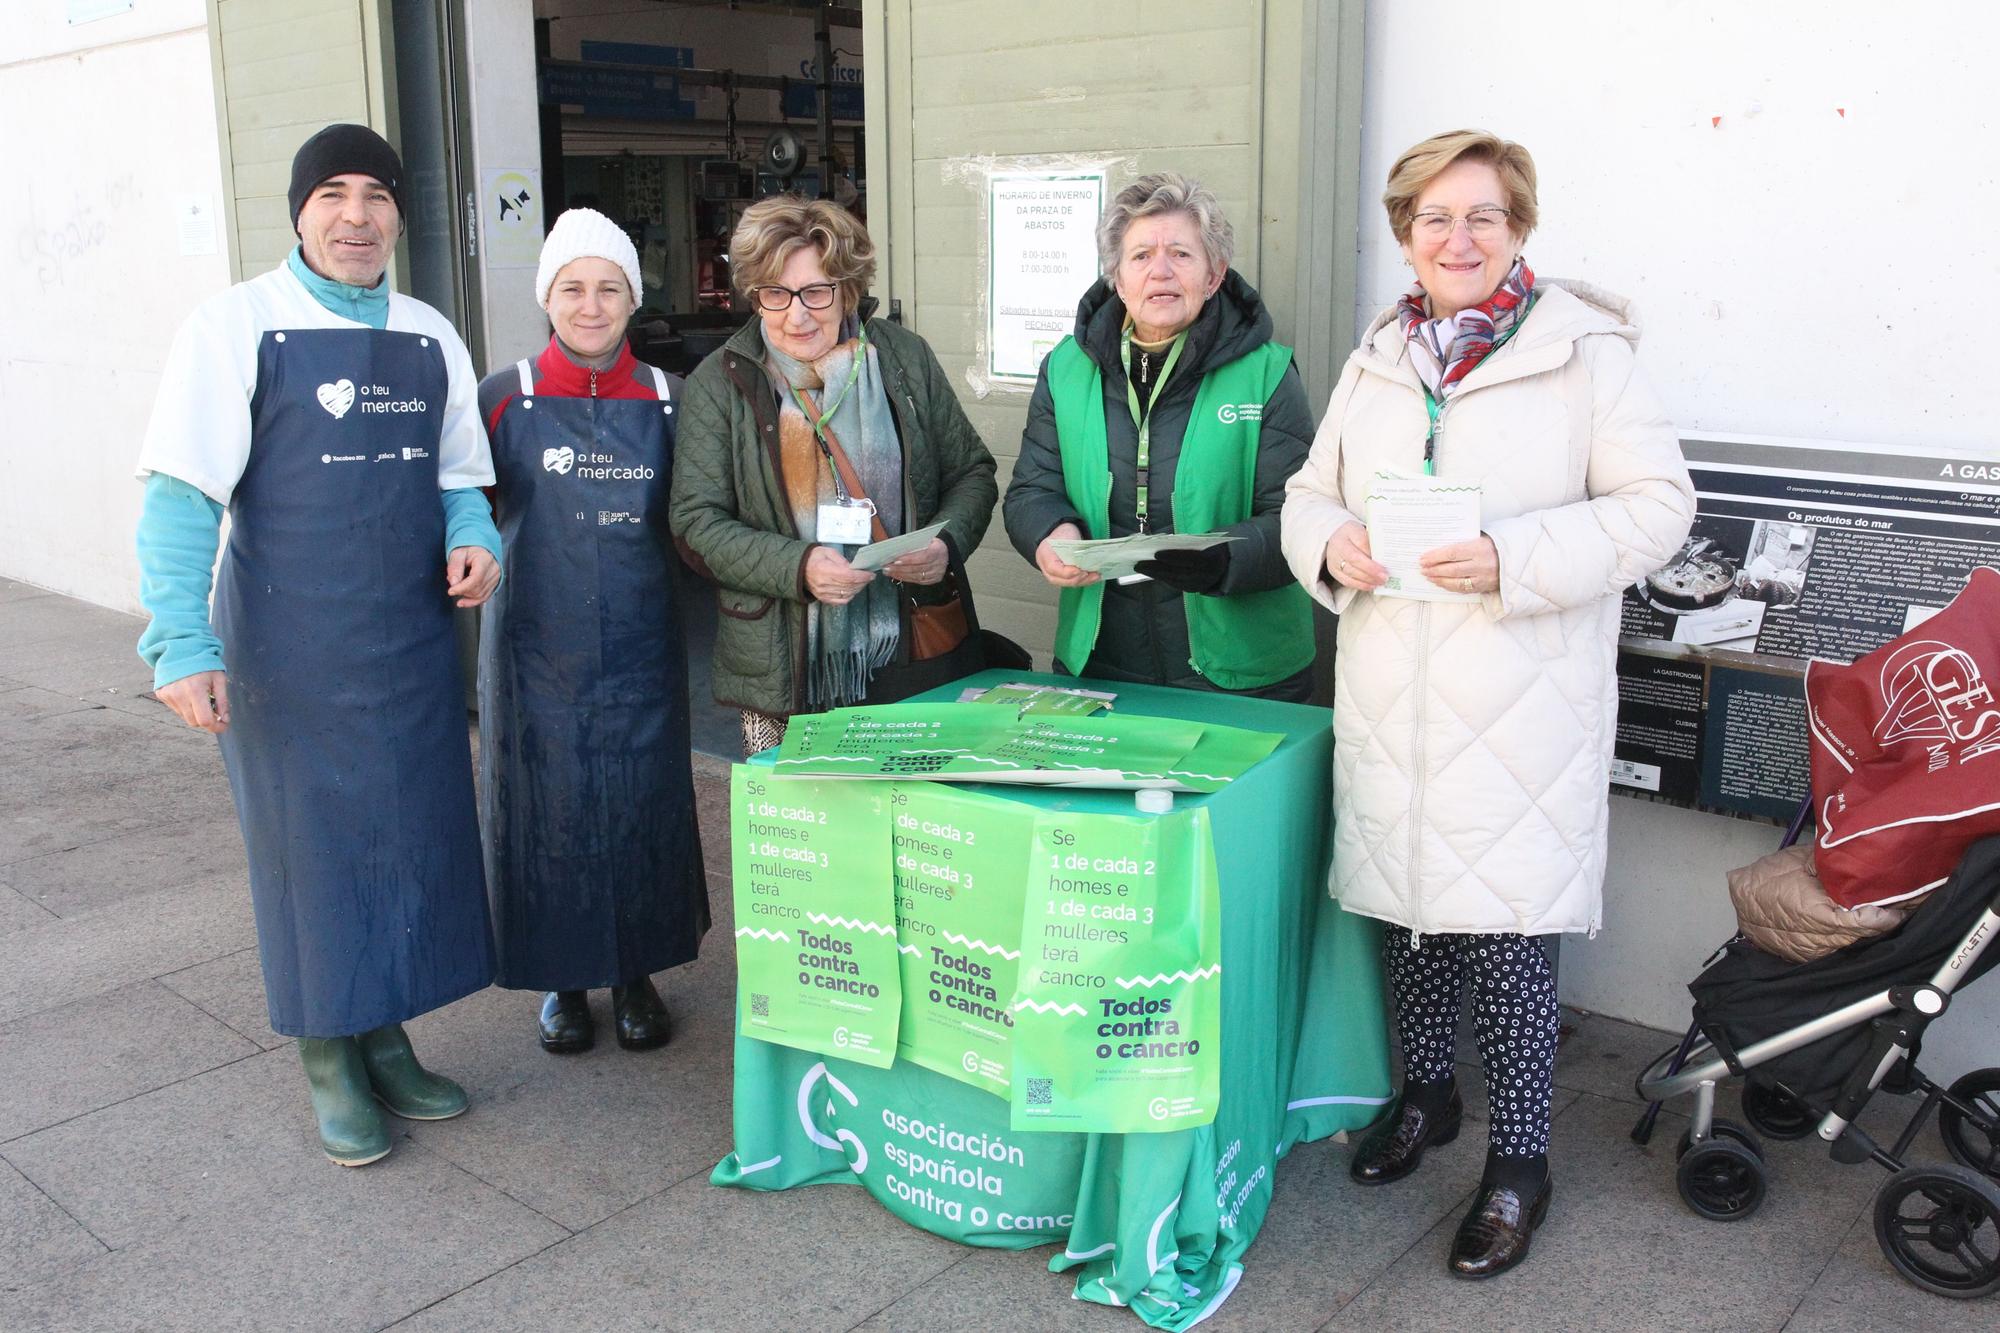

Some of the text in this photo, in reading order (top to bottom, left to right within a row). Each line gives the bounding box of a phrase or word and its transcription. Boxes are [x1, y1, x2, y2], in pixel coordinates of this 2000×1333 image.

[1039, 190, 1051, 200] DE
[1052, 190, 1093, 200] INVERNO
[1016, 206, 1073, 215] DA PRAZA DE
[1024, 220, 1065, 230] ABASTOS
[360, 384, 390, 396] o teu
[361, 397, 427, 413] mercado
[577, 452, 613, 463] o teu
[578, 464, 654, 480] mercado
[1939, 464, 1954, 477] A
[1787, 511, 1893, 530] Os produtos do mar
[1023, 739, 1047, 747] de
[1049, 743, 1088, 753] cada
[1038, 729, 1060, 737] de
[1063, 732, 1101, 743] cada
[747, 780, 766, 796] Se
[748, 801, 828, 825] 1 de cada 2
[748, 819, 809, 842] homes e
[897, 812, 975, 846] de cada 2
[1052, 829, 1075, 846] Se
[749, 841, 829, 868] 1 de cada 3
[893, 834, 953, 860] omes e
[750, 862, 812, 882] mulleres
[897, 853, 974, 889] de cada 3
[1051, 853, 1156, 876] 1 de cada 2
[751, 880, 780, 897] terá
[1049, 874, 1129, 897] homes e
[751, 902, 801, 919] cancro
[894, 893, 914, 910] erá
[1047, 899, 1154, 924] 1 de cada 3
[895, 914, 936, 936] ancro
[1044, 922, 1129, 944] mulleres
[797, 929, 854, 955] Todos
[931, 946, 992, 981] Todos
[1042, 943, 1079, 963] terá
[798, 952, 860, 976] contra
[798, 972, 880, 998] o cancro
[929, 969, 997, 1002] contra
[1039, 970, 1107, 989] cancro
[928, 988, 942, 1003] o
[1099, 996, 1172, 1018] Todos
[1097, 1017, 1180, 1038] contra
[1096, 1039, 1200, 1059] o cancro
[882, 1108, 1024, 1168] asociación
[884, 1141, 1002, 1196] española
[1237, 1165, 1265, 1206] cancro
[886, 1173, 1074, 1231] contra o canc
